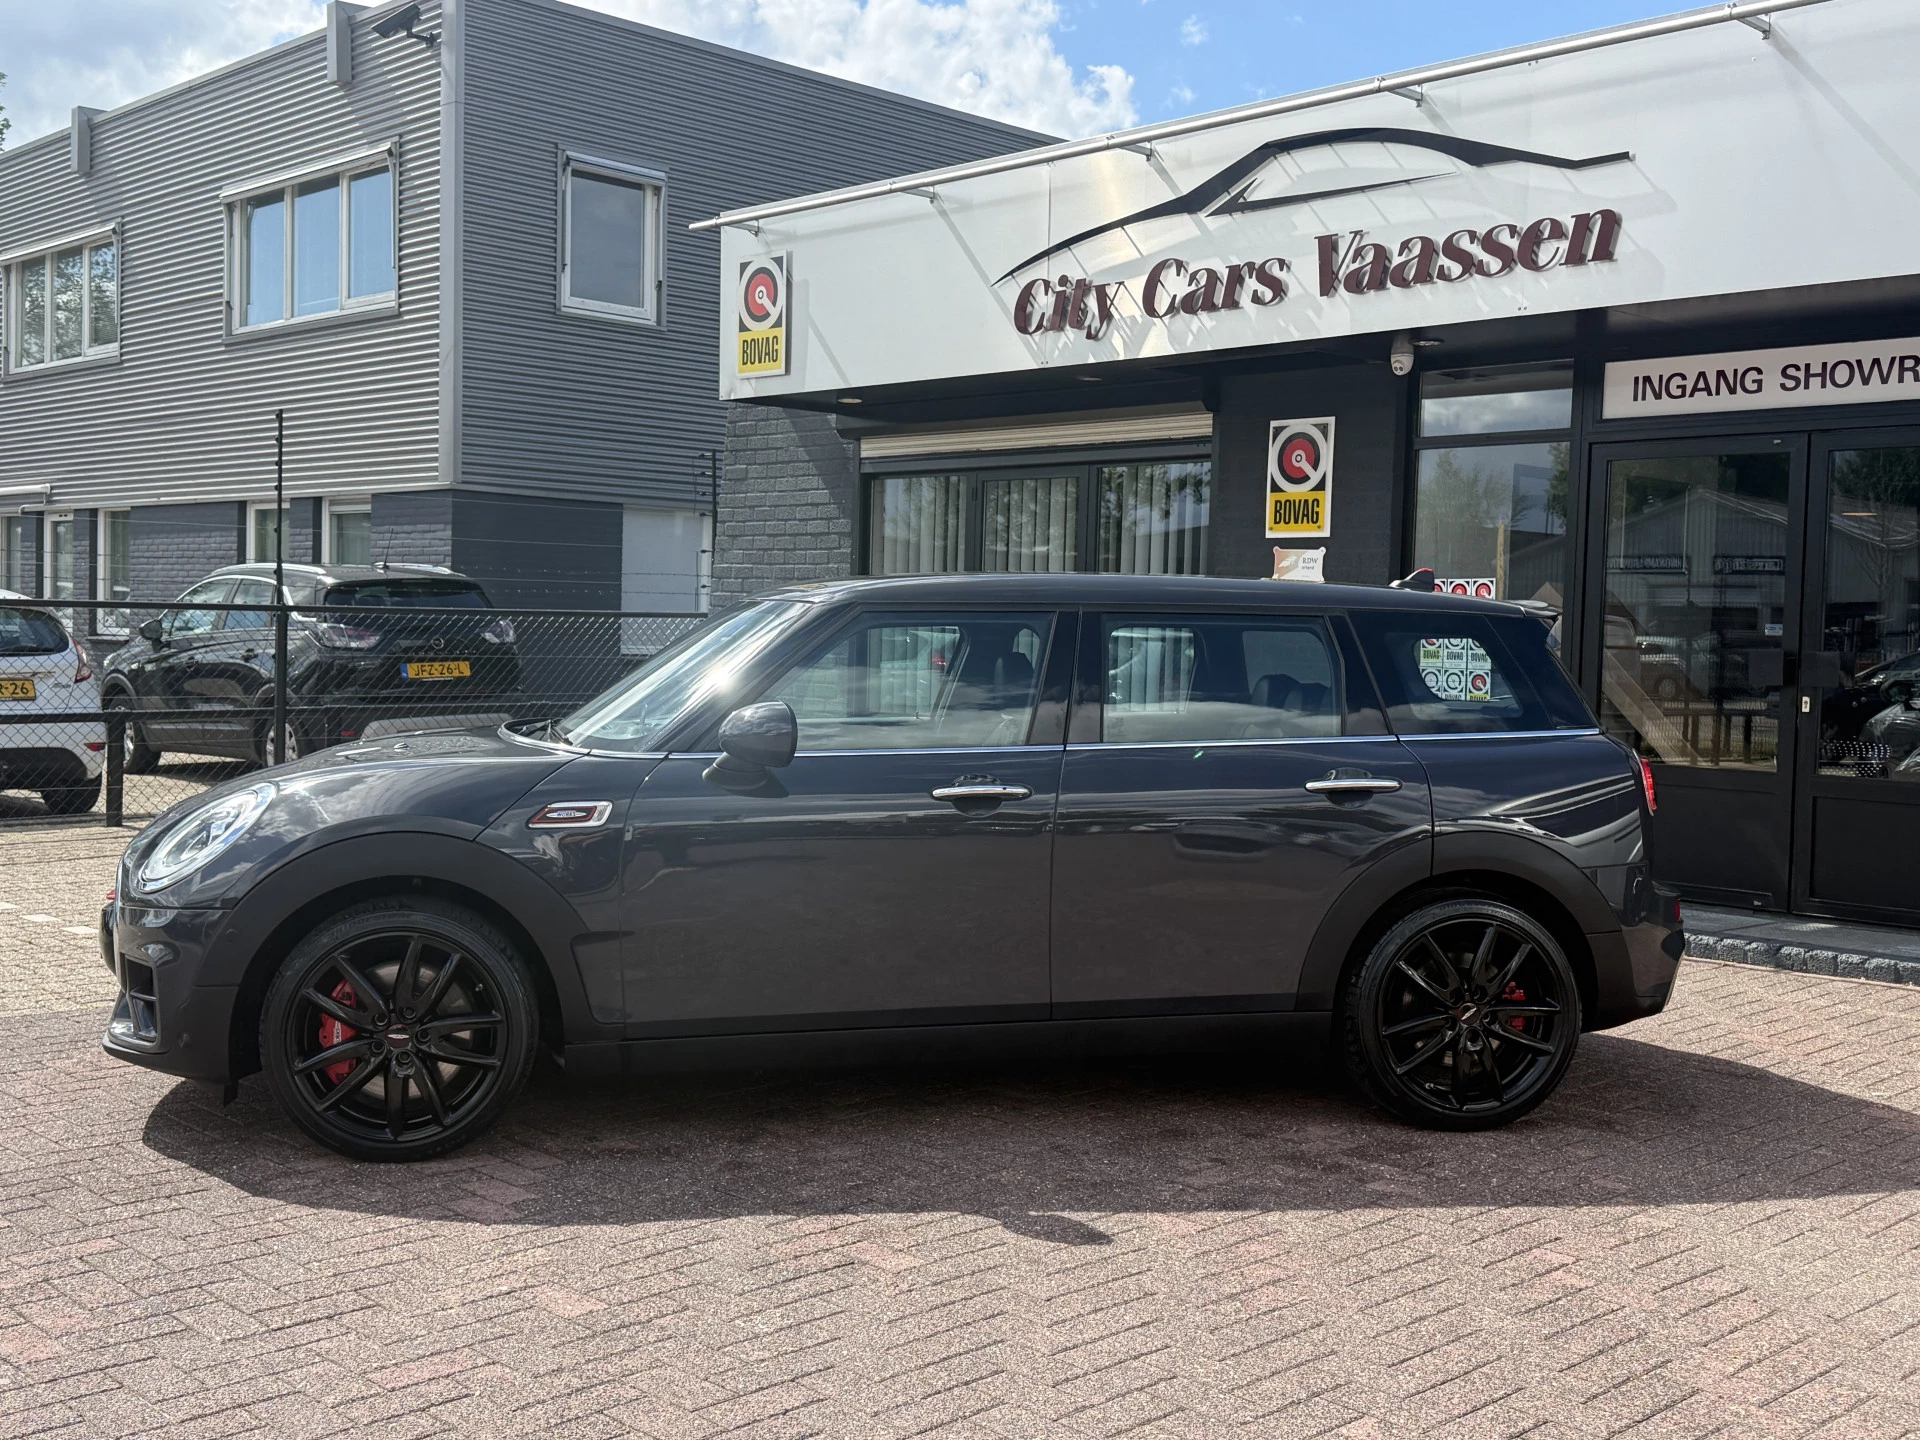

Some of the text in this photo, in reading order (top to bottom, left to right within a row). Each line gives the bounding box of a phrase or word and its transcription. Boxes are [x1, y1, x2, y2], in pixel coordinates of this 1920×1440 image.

[1014, 208, 1617, 341] City Cars Vaassen
[742, 335, 779, 366] BOVAG
[1632, 366, 1764, 402] INGANG
[1273, 498, 1320, 525] BOVAG
[414, 663, 464, 676] JFZ-26-L
